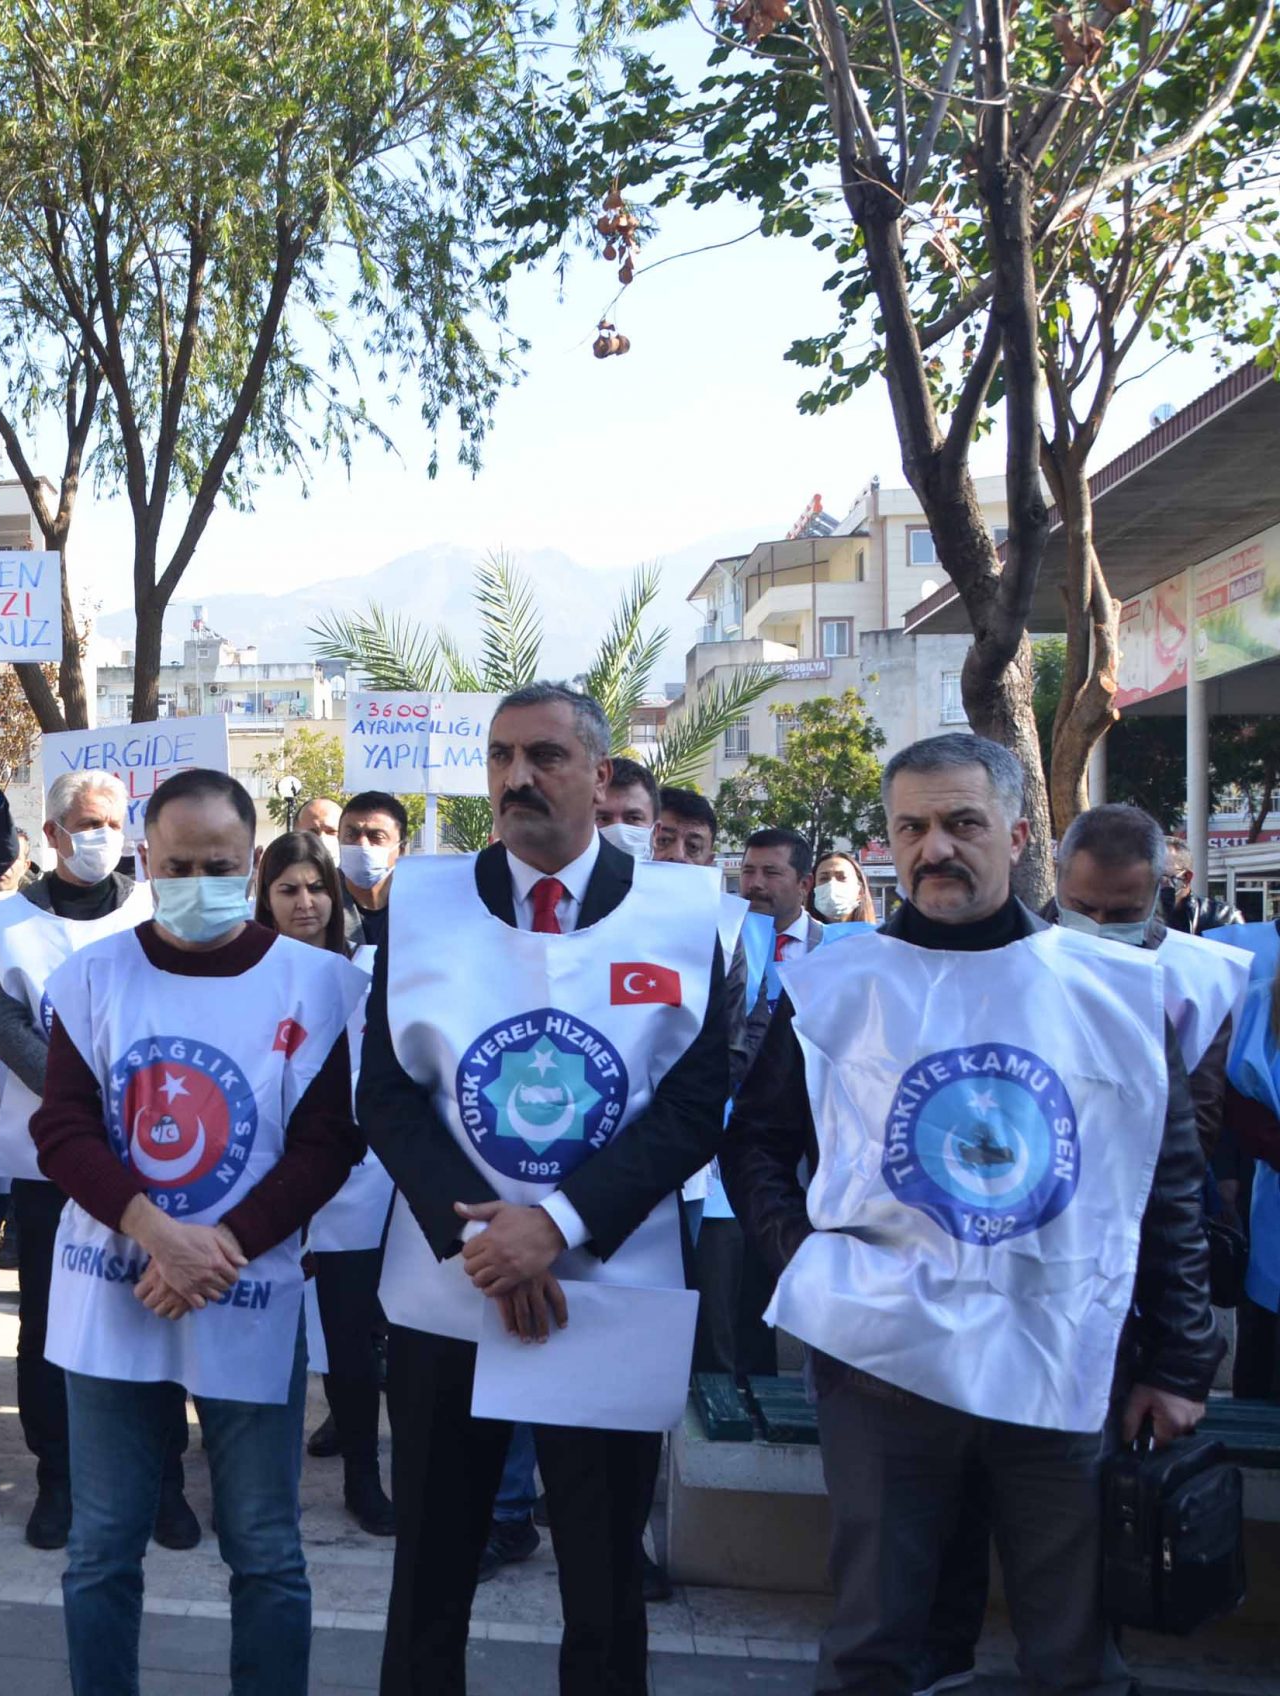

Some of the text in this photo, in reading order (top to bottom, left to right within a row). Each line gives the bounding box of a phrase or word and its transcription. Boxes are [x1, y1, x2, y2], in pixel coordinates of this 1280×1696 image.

[351, 715, 482, 736] AYRIMCILIĞI
[59, 731, 197, 771] VERGİDE
[362, 743, 489, 770] YAPILMA
[470, 1019, 540, 1068] YEREL
[544, 1015, 621, 1082] HİZMET
[127, 1041, 240, 1091] SAĞLIK
[214, 1119, 252, 1185] SEN
[460, 1071, 489, 1144] TÜRK
[589, 1100, 621, 1149] SEN
[957, 1050, 1051, 1093] KAMU
[1052, 1115, 1075, 1182] SEN
[517, 1159, 561, 1177] 1992
[155, 1192, 190, 1211] 92
[962, 1213, 1017, 1239] 1992
